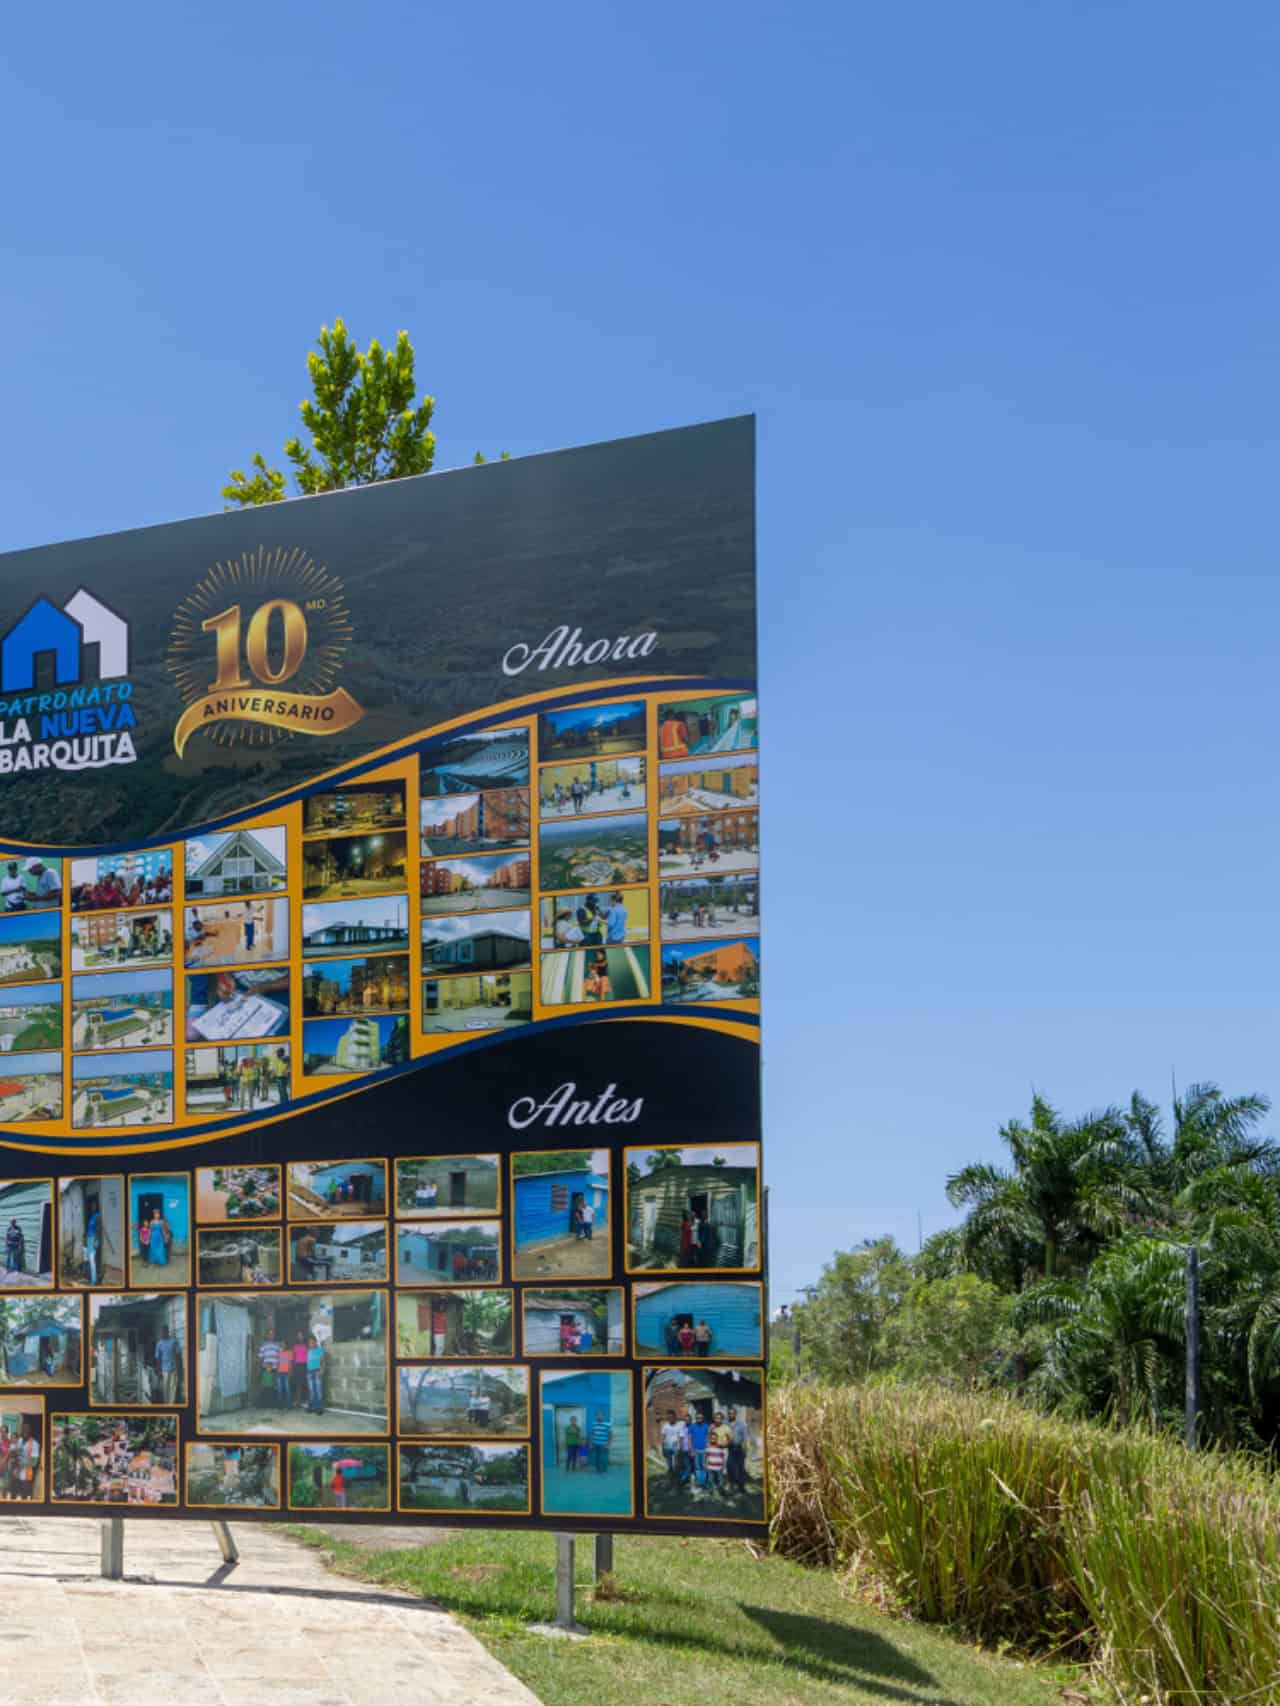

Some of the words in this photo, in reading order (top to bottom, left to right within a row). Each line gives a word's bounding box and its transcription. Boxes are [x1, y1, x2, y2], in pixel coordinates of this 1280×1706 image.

[201, 597, 308, 692] 10
[502, 624, 658, 676] Ahora
[39, 703, 137, 740] NUEVA
[203, 697, 335, 721] ANIVERSARIO
[507, 1081, 645, 1130] Antes
